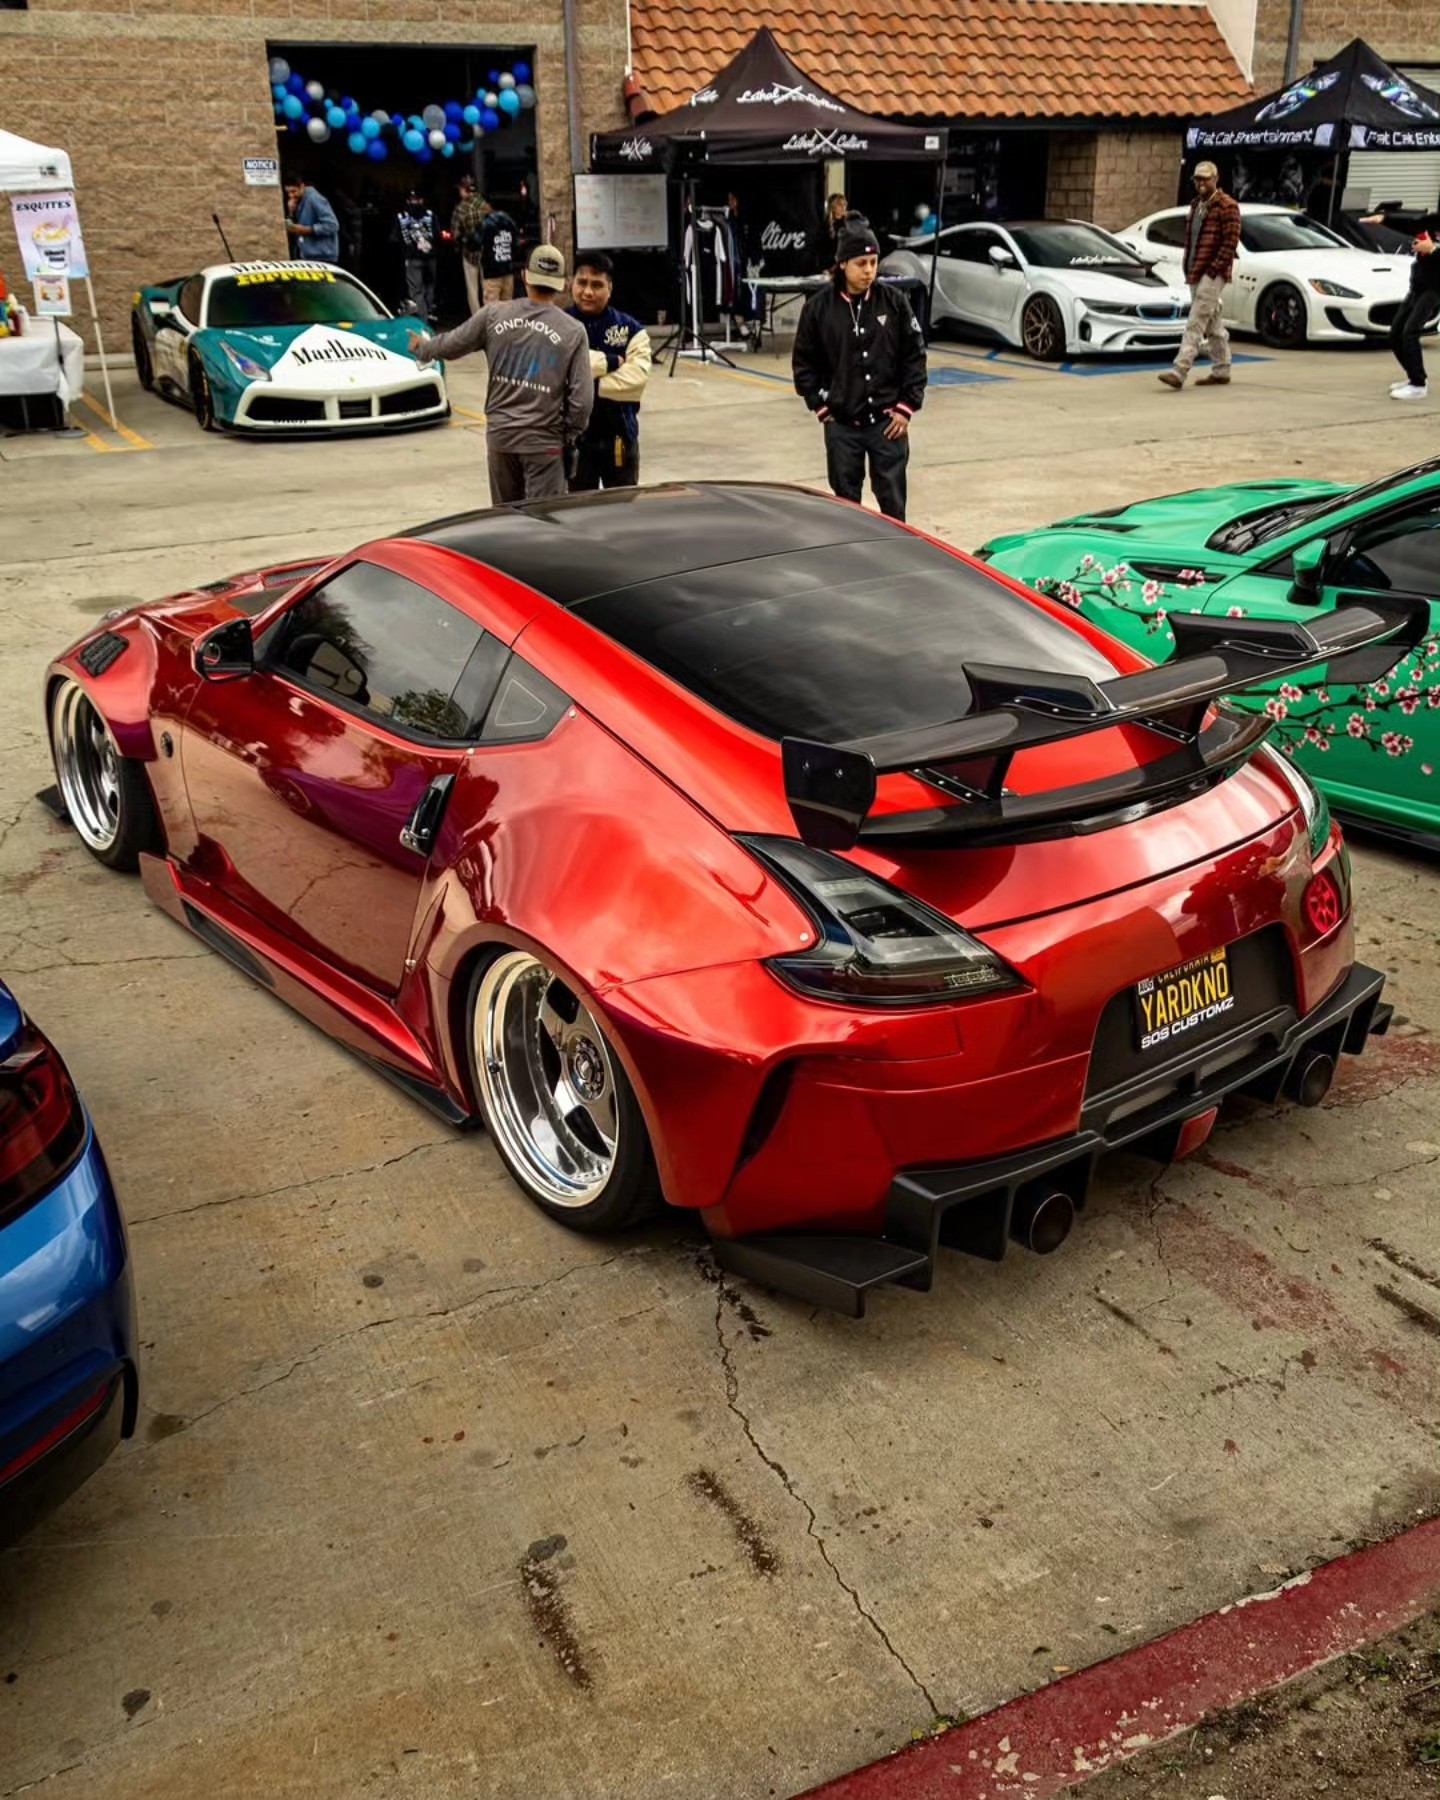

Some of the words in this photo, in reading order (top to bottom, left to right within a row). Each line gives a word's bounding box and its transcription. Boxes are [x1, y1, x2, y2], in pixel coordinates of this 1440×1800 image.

[1197, 131, 1216, 145] Fat
[1215, 131, 1236, 145] Cat
[1233, 127, 1313, 144] Entertainment
[1366, 130, 1390, 145] Fat
[1392, 131, 1415, 145] Cat
[246, 160, 275, 169] NOTICE
[16, 200, 71, 212] ESQUITES
[291, 339, 387, 366] Marlboro
[1141, 961, 1228, 1033] YARDKNO
[1141, 1026, 1170, 1049] SOS
[1171, 996, 1235, 1035] CUSTOMZ
